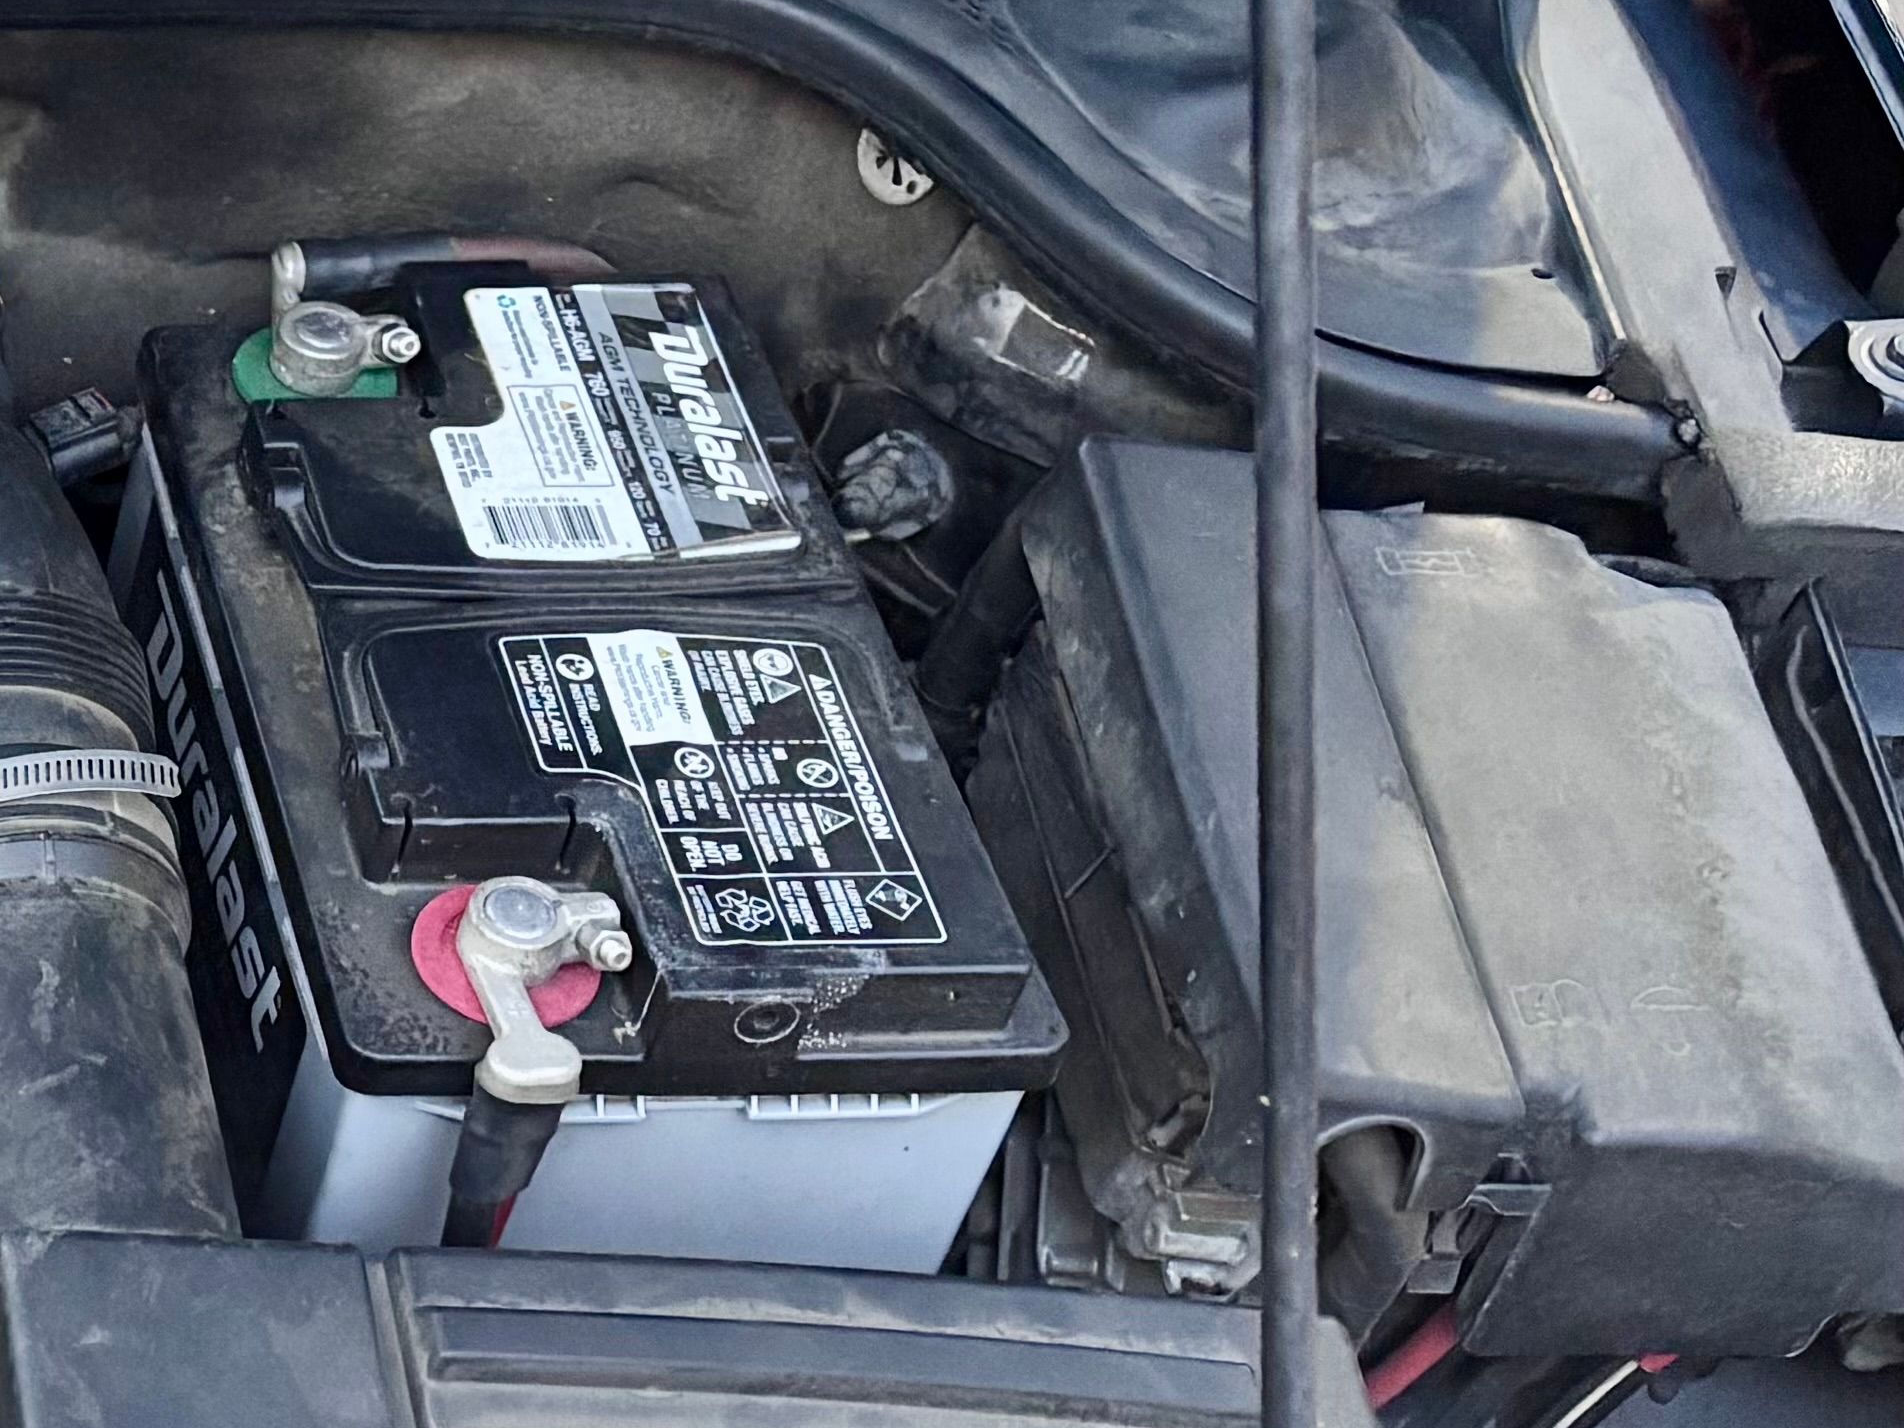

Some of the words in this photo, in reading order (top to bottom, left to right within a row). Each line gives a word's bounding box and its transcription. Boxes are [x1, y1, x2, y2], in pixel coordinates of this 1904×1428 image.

[564, 411, 600, 471] WARNING:
[596, 331, 625, 371] AGM
[616, 377, 675, 494] TECHNOLOGY
[645, 325, 770, 505] Duralast
[650, 392, 710, 500] PLATINUM
[525, 654, 574, 751] NON-SPILLABLE
[579, 683, 603, 711] READ
[147, 570, 281, 1052] Duralast
[813, 690, 894, 839] DANGER/POISON
[677, 835, 710, 872] OPEN.
[699, 840, 726, 866] NOT
[719, 843, 744, 861] DO
